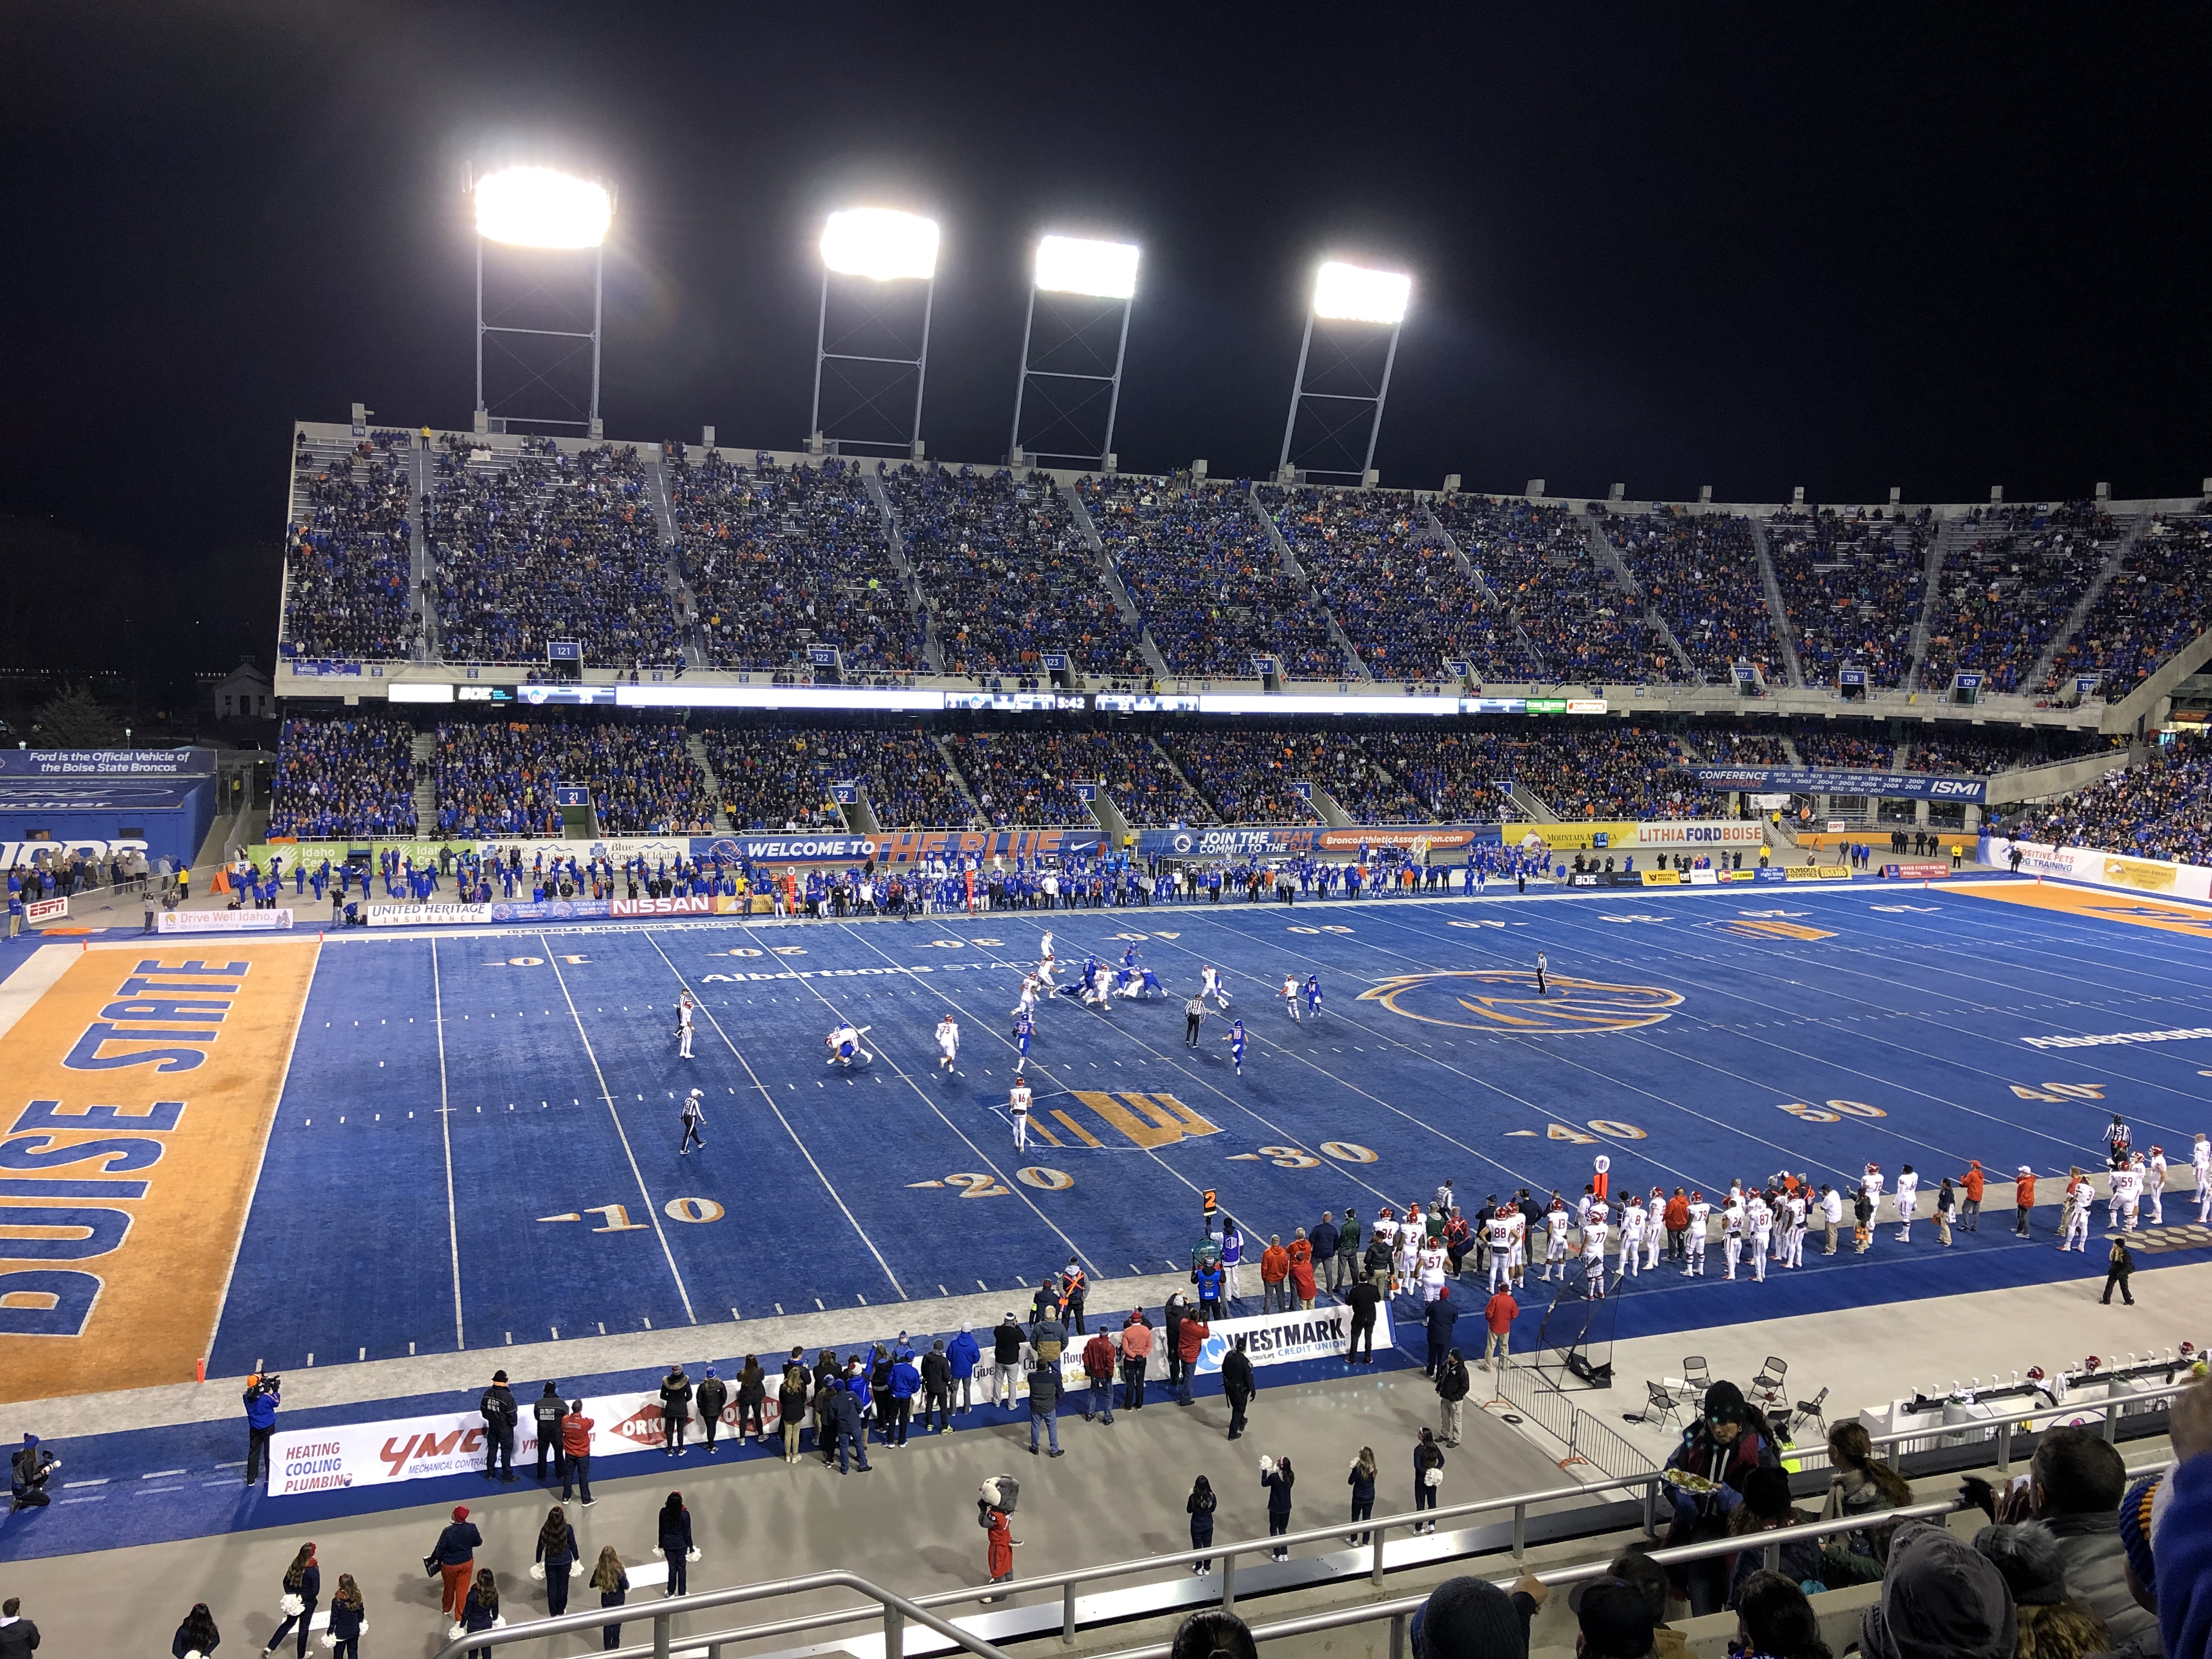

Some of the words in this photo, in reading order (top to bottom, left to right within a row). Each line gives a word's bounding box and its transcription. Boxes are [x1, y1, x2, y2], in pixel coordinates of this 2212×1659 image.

[557, 647, 570, 656] 121
[1047, 658, 1059, 667] 123
[1057, 697, 1085, 709] 5:42
[30, 752, 56, 761] Ford
[59, 752, 69, 760] is
[71, 752, 90, 760] the
[92, 752, 133, 761] Official
[136, 752, 174, 761] Vehicle
[177, 752, 190, 761] of
[41, 763, 60, 771] the
[63, 763, 94, 771] Boise
[131, 763, 177, 771] Broncos
[1699, 771, 1769, 780] CONFERENCE
[1703, 779, 1763, 788] CHAMPIONS
[1931, 781, 1981, 795] ISMI
[568, 792, 579, 800] 21
[838, 791, 849, 799] 22
[1200, 832, 1237, 845] JOIN
[1240, 832, 1269, 844] THE
[1273, 832, 1313, 843] TEAM
[303, 847, 335, 857] Idaho
[748, 842, 845, 856] WELCOME
[850, 842, 875, 854] TO
[864, 833, 950, 863] THE
[955, 832, 1064, 861] BLUE
[1199, 843, 1242, 854] COMMIT
[1248, 843, 1261, 852] TO
[1266, 843, 1287, 852] THE
[643, 851, 651, 860] of
[2054, 853, 2074, 864] PETS
[2034, 859, 2072, 871] TRAINING
[2125, 866, 2151, 874] MOUNTAIN
[1575, 875, 1597, 885] BOE
[29, 899, 65, 917] ESPN
[372, 905, 421, 916] UNITED
[424, 904, 484, 915] HERITAGE
[613, 897, 709, 914] NISSAN
[180, 912, 211, 923] Drive
[213, 912, 236, 922] Well
[238, 911, 273, 921] Idaho.
[384, 915, 476, 923] INSURANCE
[701, 965, 934, 983] Albertsons
[60, 959, 253, 1073] STATE
[941, 1026, 950, 1035] 73
[1017, 1025, 1027, 1035] 93
[1233, 1030, 1241, 1040] 10
[1018, 1093, 1025, 1103] 16
[2121, 1177, 2133, 1187] 59
[1204, 1192, 1216, 1208] 2
[2087, 1191, 2093, 1201] 3
[1635, 1215, 1641, 1226] 8
[1699, 1210, 1708, 1221] 79
[1759, 1213, 1769, 1224] 87
[1558, 1218, 1566, 1229] 13
[1732, 1216, 1741, 1227] 26
[1494, 1227, 1506, 1239] 88
[1516, 1222, 1524, 1233] 89
[1410, 1232, 1417, 1243] 2
[1596, 1232, 1605, 1243] 77
[1429, 1256, 1441, 1269] 57
[1227, 1318, 1346, 1352] WESTMARK
[1278, 1346, 1311, 1357] CREDIT
[1315, 1340, 1346, 1351] UNION
[974, 1366, 995, 1383] Give
[286, 1442, 340, 1460] HEATING
[380, 1428, 489, 1477] YMC
[285, 1458, 342, 1477] COOLING
[408, 1460, 452, 1475] MECHANICAL
